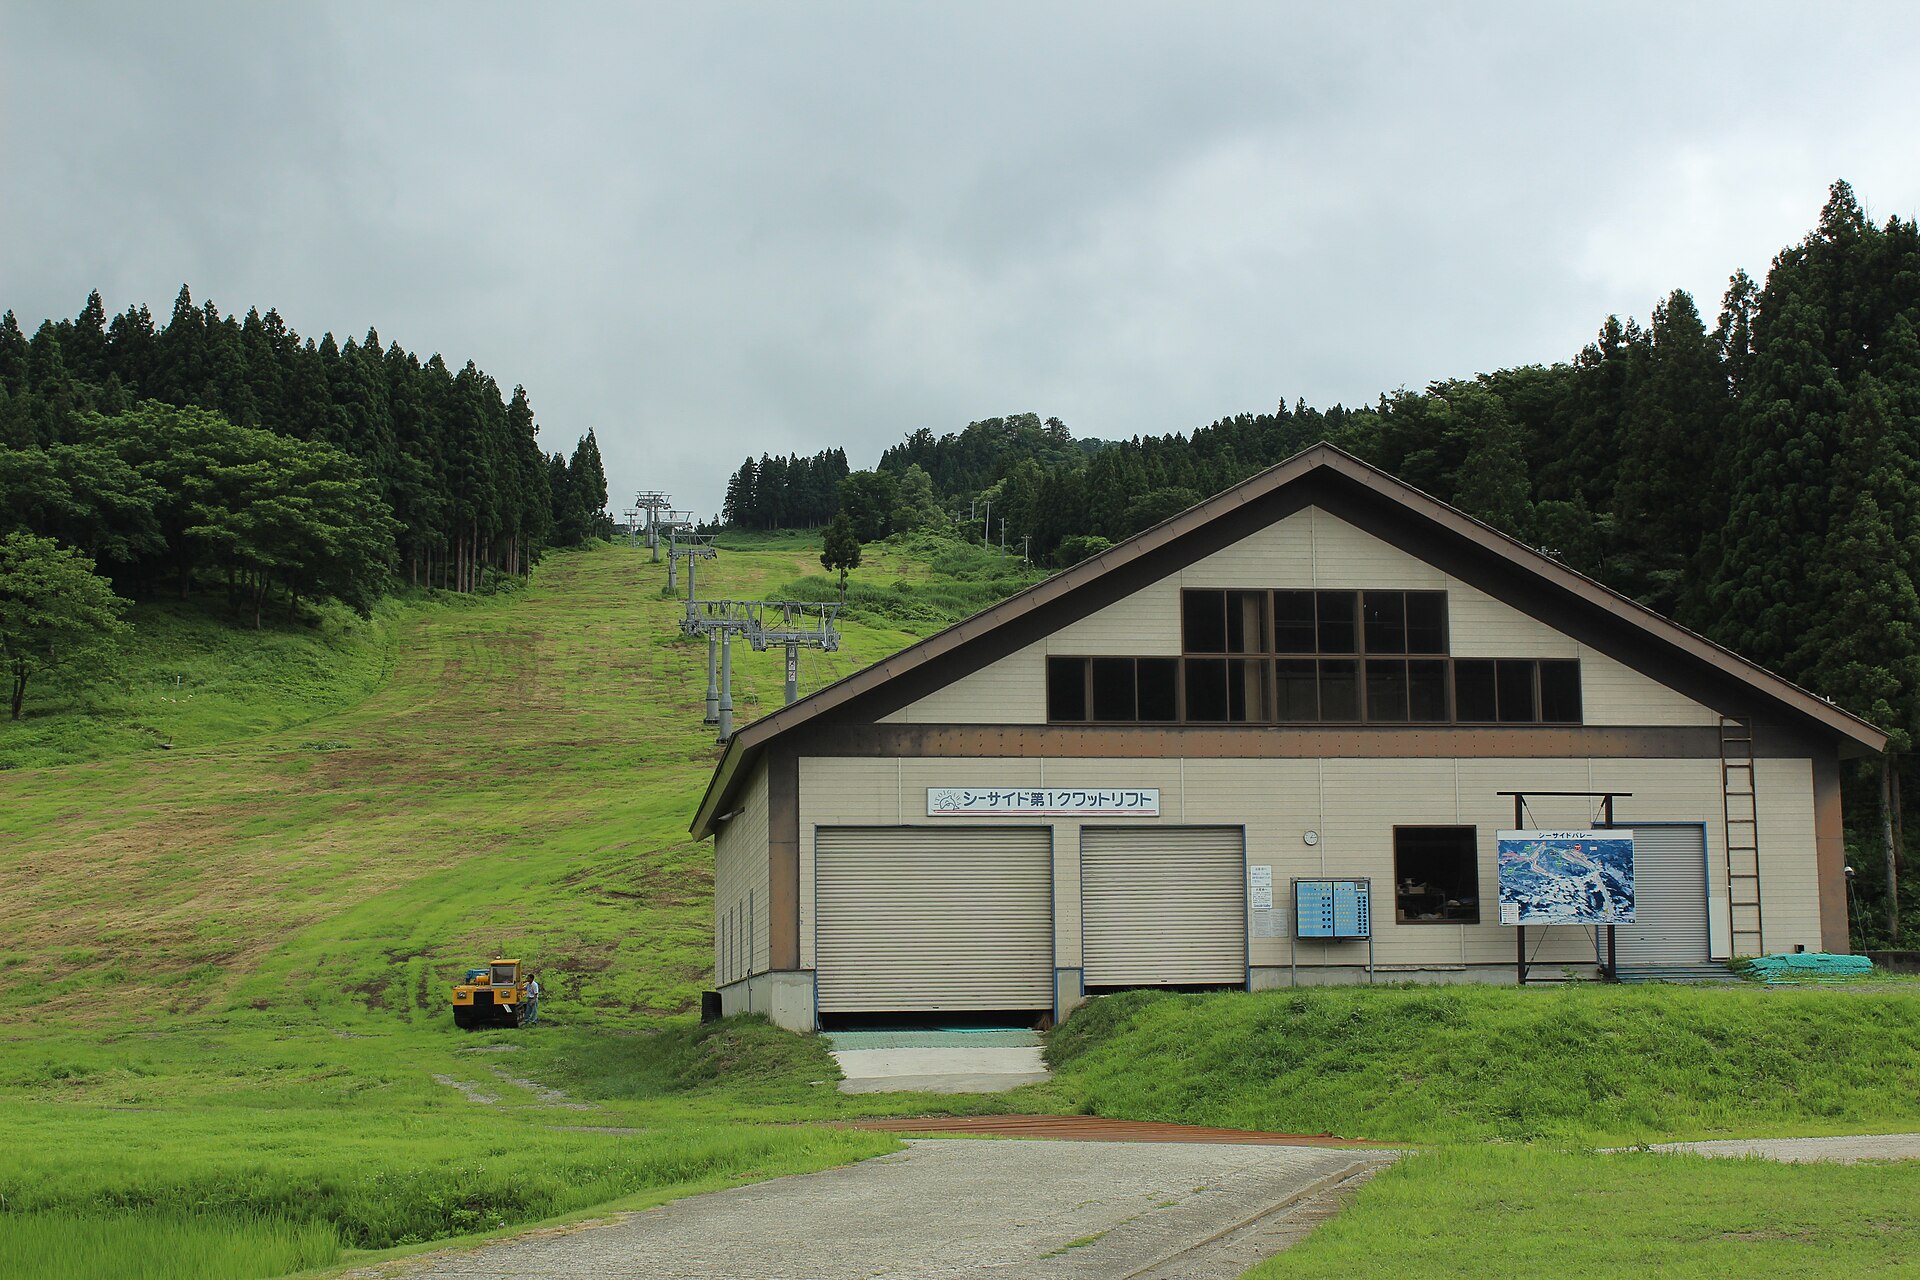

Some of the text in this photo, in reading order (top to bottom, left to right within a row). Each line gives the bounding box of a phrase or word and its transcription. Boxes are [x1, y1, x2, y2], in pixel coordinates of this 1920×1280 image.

[963, 791, 1152, 806] シーサイド第1クワットリフト
